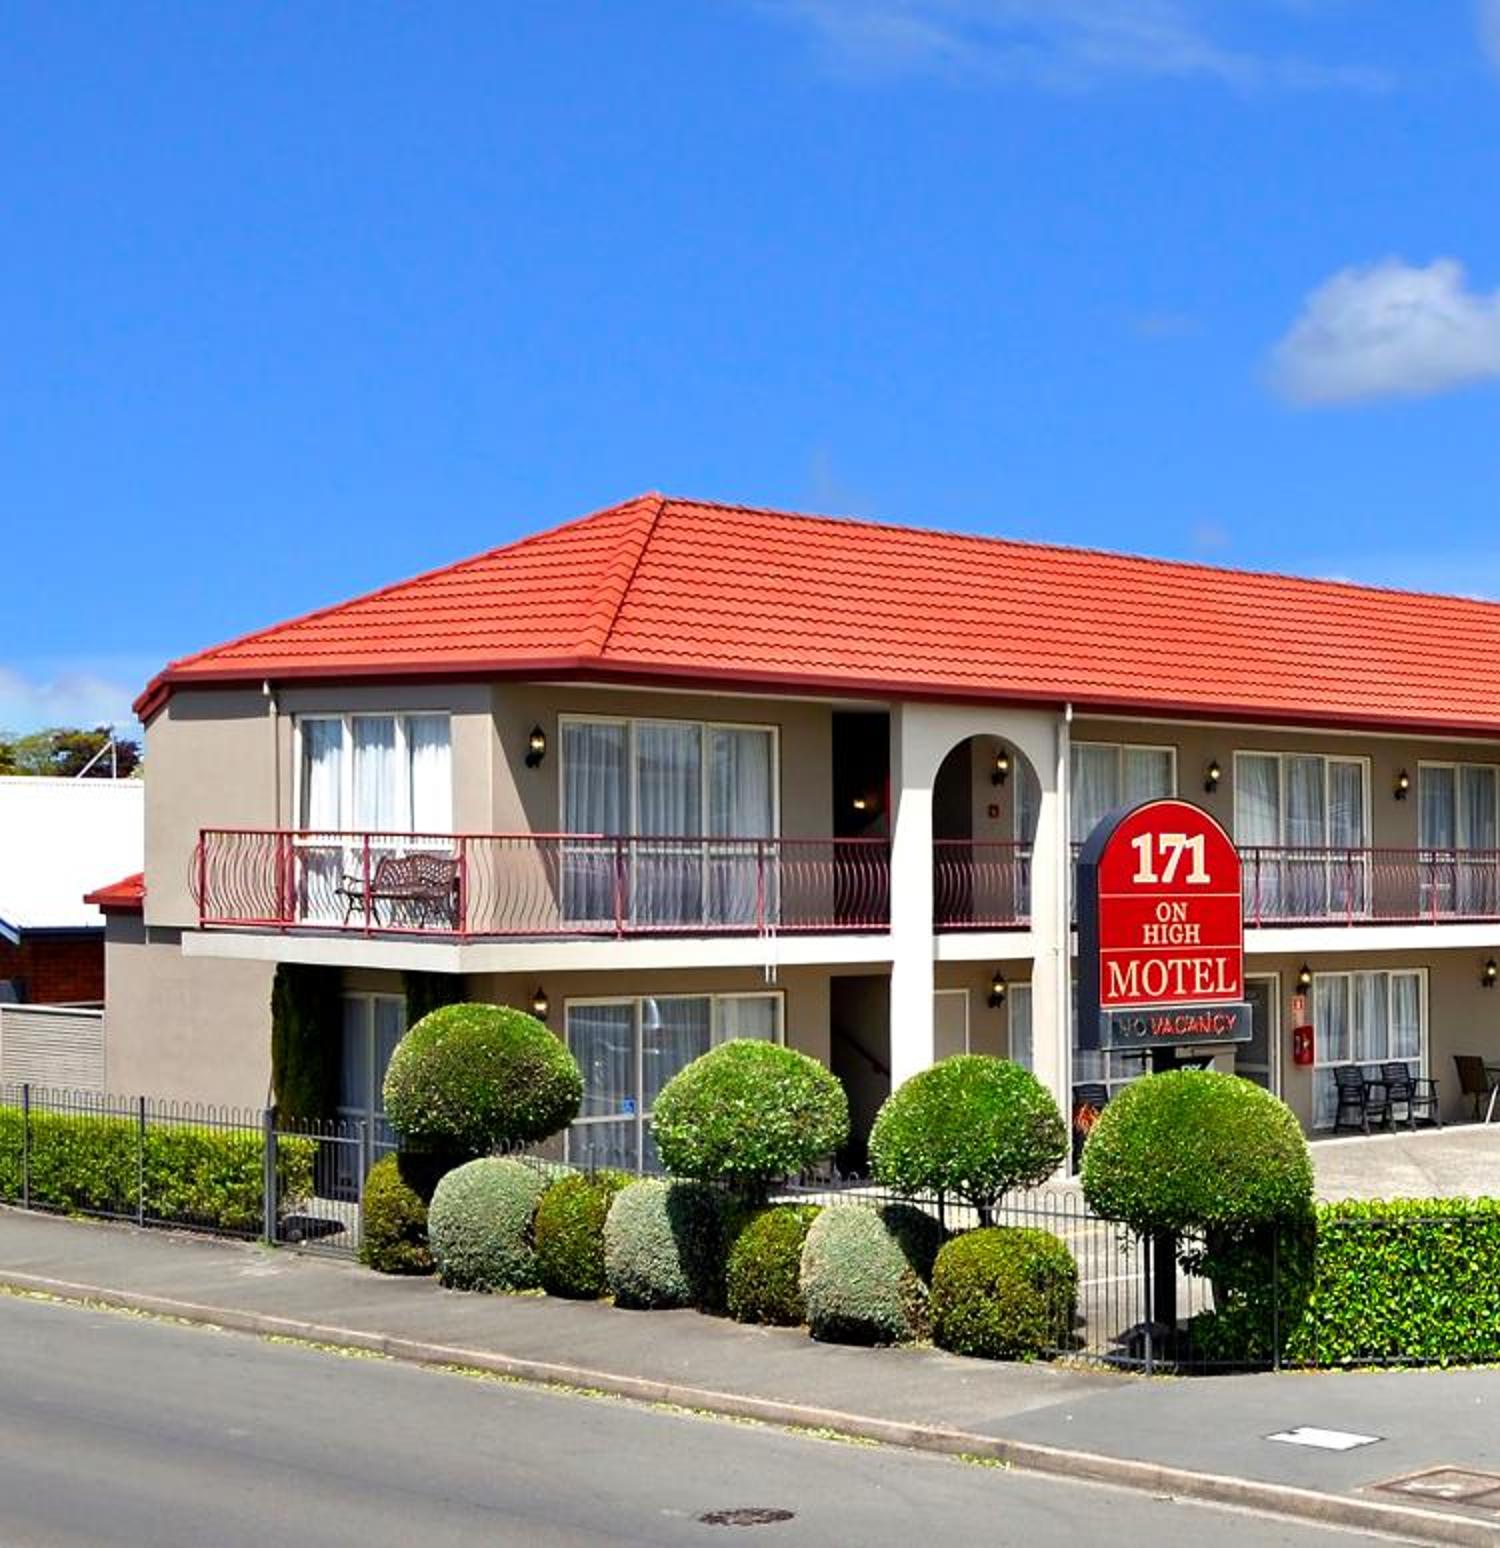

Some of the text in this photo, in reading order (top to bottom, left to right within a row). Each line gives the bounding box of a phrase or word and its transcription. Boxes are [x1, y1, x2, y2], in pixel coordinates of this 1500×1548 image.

[1131, 832, 1211, 884] 171
[1155, 902, 1188, 922] ON
[1143, 923, 1201, 945] HIGH
[1107, 957, 1238, 998] MOTEL
[1151, 1010, 1238, 1036] VACANCY
